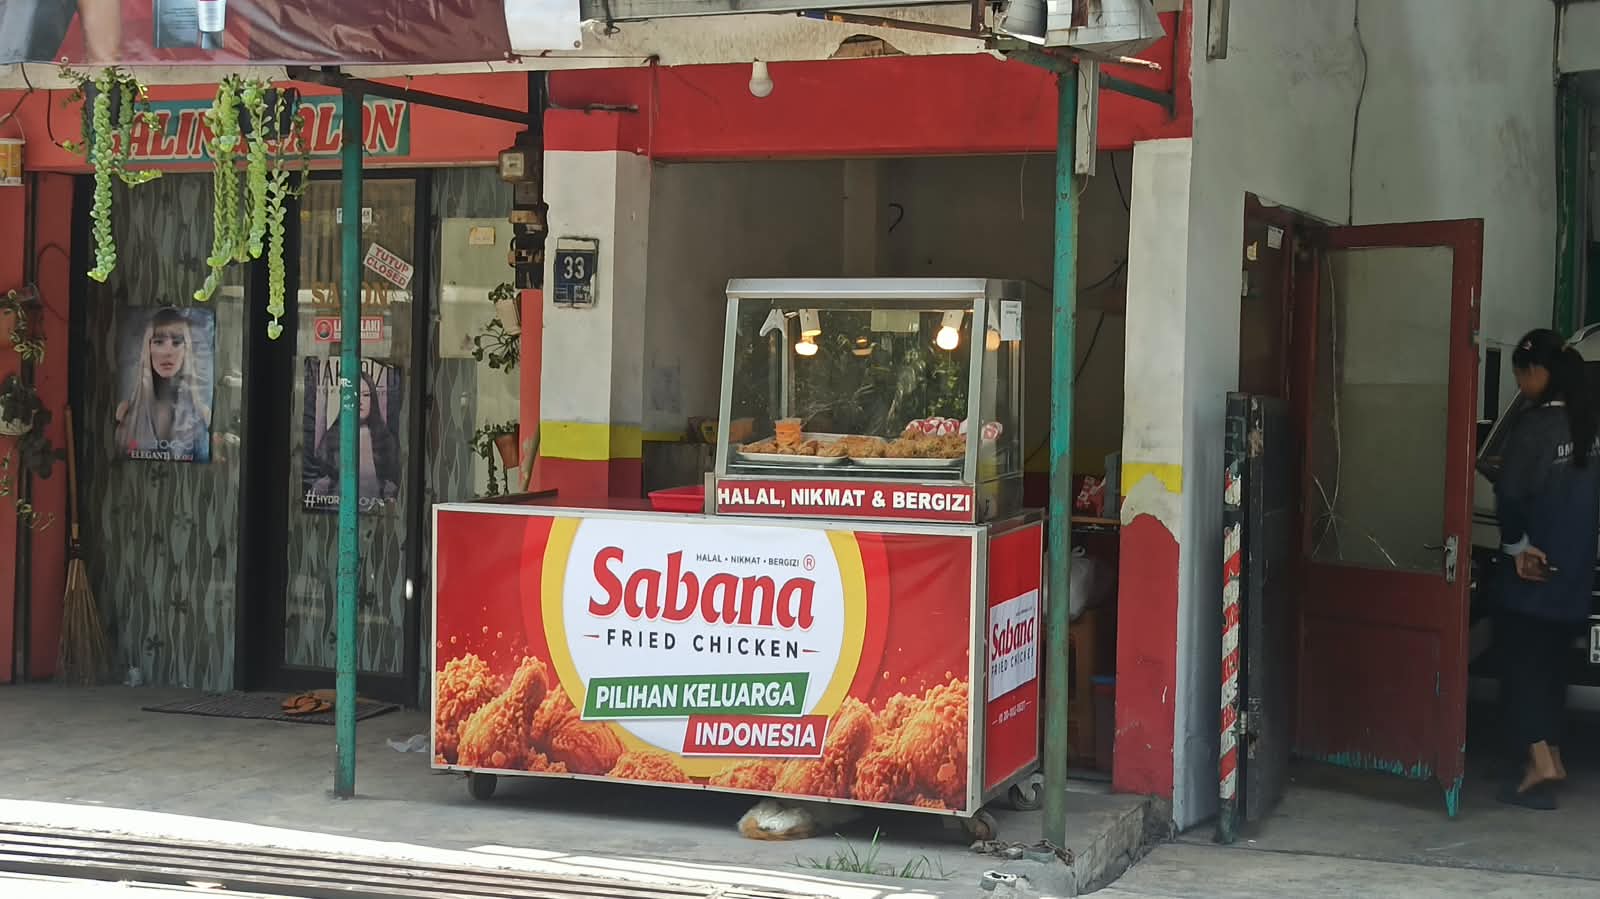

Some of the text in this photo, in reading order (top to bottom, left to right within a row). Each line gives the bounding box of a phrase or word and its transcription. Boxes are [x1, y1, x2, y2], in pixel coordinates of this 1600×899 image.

[262, 101, 406, 155] ALN
[367, 256, 406, 287] CLOSED
[375, 247, 409, 273] TUTUP
[563, 255, 585, 279] 33
[312, 281, 391, 308] SAON
[717, 487, 971, 512] HALAL, NIKMAT & BERGIZI
[696, 553, 723, 563] HALAL
[731, 555, 761, 565] NIKMAT
[768, 557, 800, 567] BERGIZI
[588, 546, 817, 631] Sabana
[607, 628, 799, 659] FRIED CHICKEN
[991, 616, 1035, 661] Sabana
[595, 681, 796, 709] PILIHAN KELUARGA
[695, 721, 817, 747] INDONESIA
